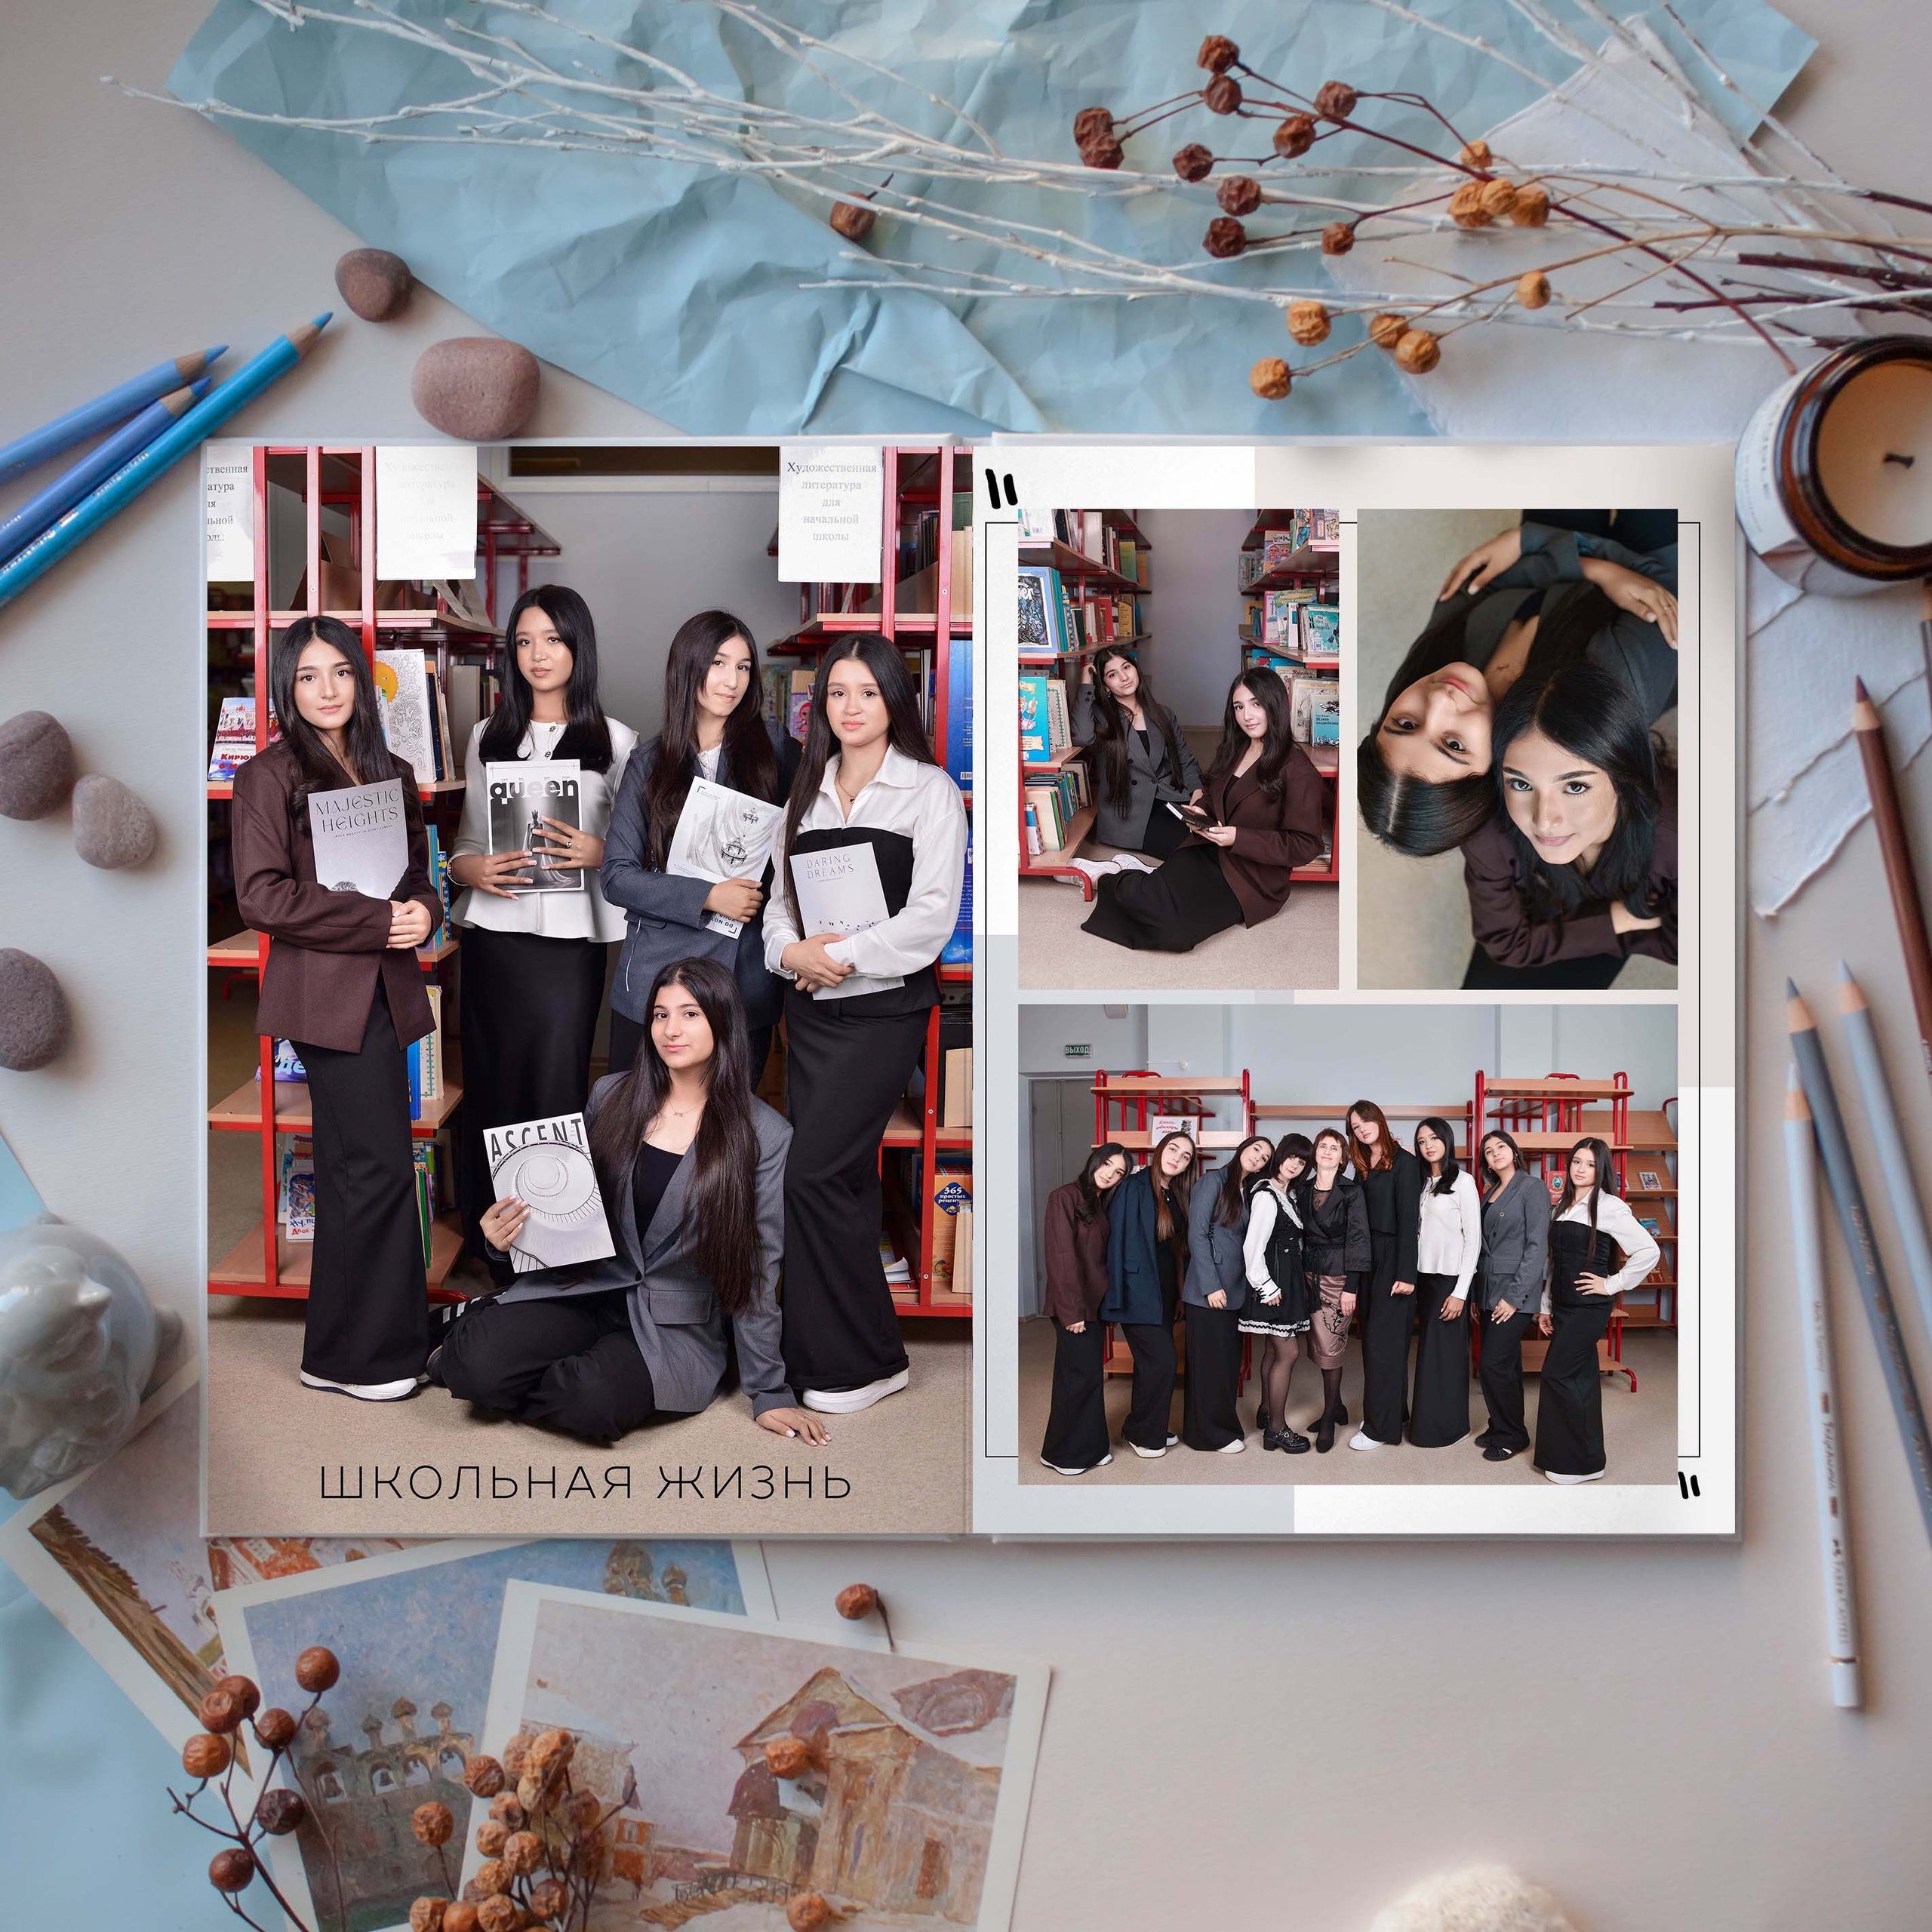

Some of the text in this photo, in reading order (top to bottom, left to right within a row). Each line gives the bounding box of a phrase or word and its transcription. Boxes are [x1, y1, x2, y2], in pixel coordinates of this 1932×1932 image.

[787, 462, 877, 475] Художественная
[801, 481, 862, 492] литература
[821, 499, 841, 507] для
[803, 514, 859, 524] начальной
[813, 533, 849, 541] школы
[490, 780, 579, 804] queen
[315, 788, 399, 815] MAJESTIC
[322, 806, 398, 832] HEIGHTS
[806, 854, 851, 869] DARING
[807, 864, 854, 879] DREAMS
[1065, 1046, 1089, 1055] ВЫХОД
[491, 1118, 583, 1163] ASCENT
[943, 1186, 962, 1195] 365
[320, 1465, 851, 1500] ШКОЛЬНАЯ ЖИЗНЬ
